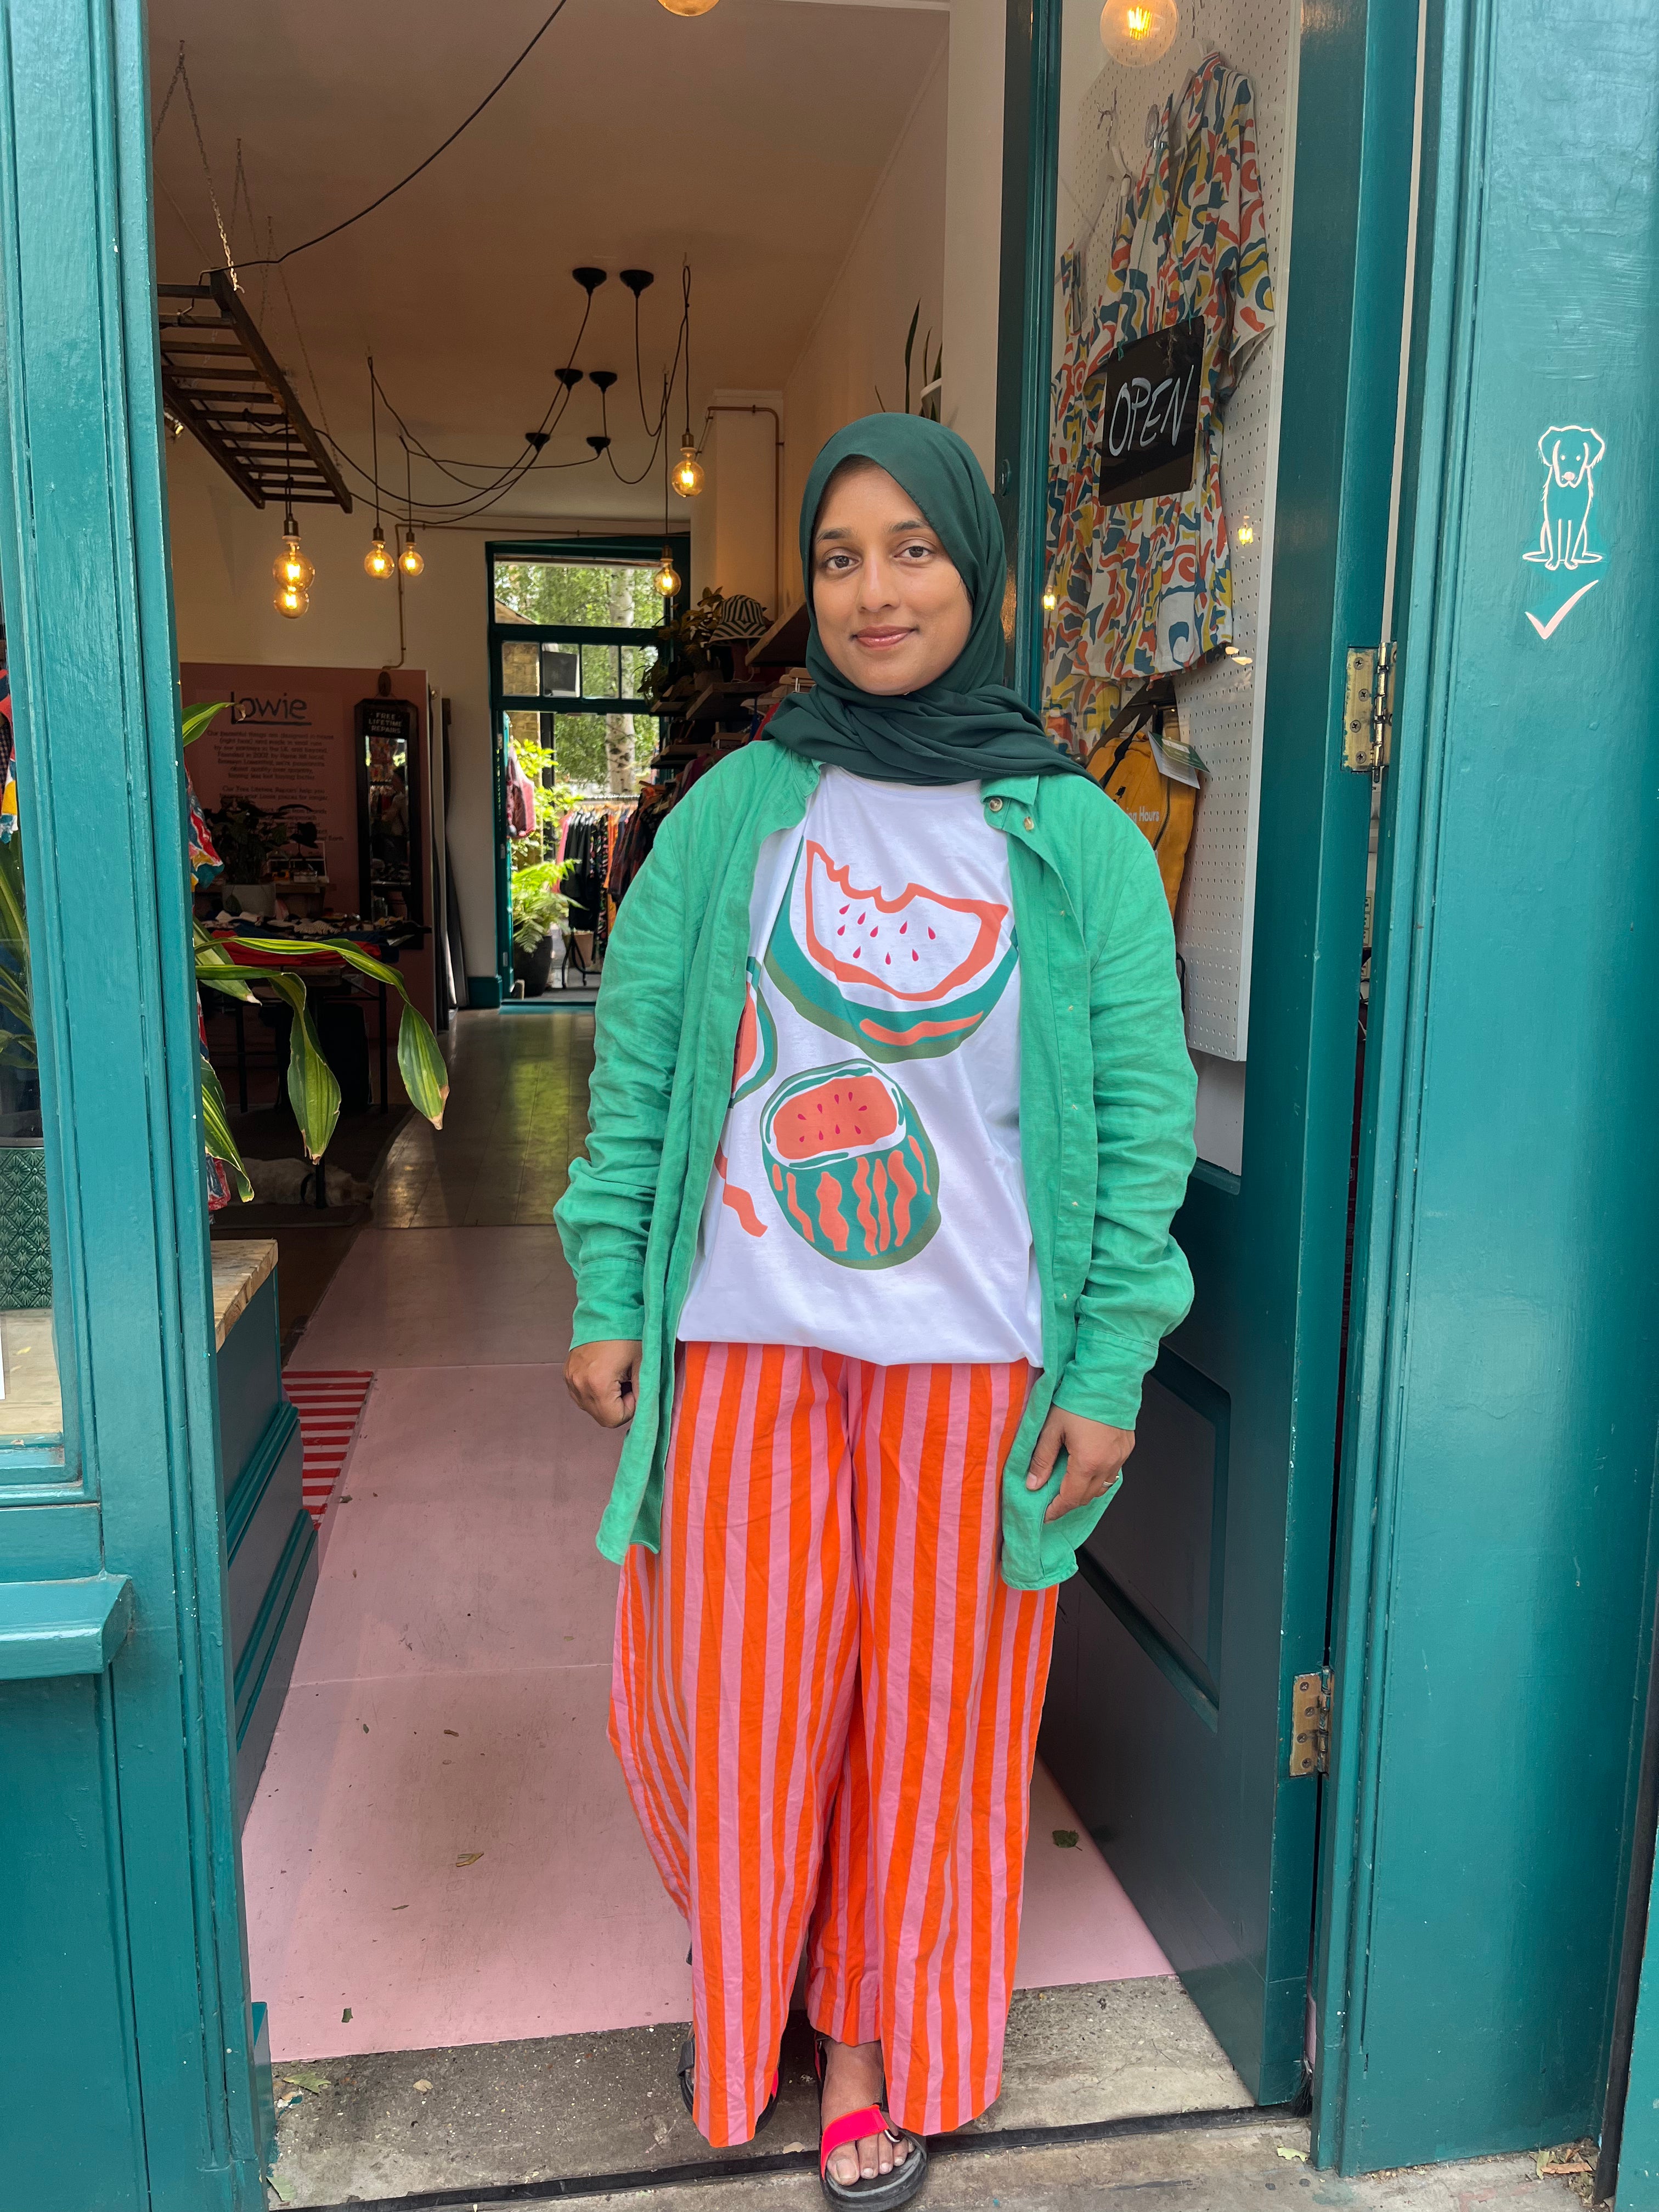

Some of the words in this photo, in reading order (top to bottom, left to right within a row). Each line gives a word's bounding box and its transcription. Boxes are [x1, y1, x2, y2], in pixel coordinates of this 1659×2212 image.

[1109, 364, 1194, 457] OPEN
[230, 691, 312, 725] Lowie
[368, 718, 402, 727] LIFETIME
[376, 712, 396, 720] FREE
[371, 725, 401, 734] REPAIRS
[1139, 805, 1160, 822] Hours
